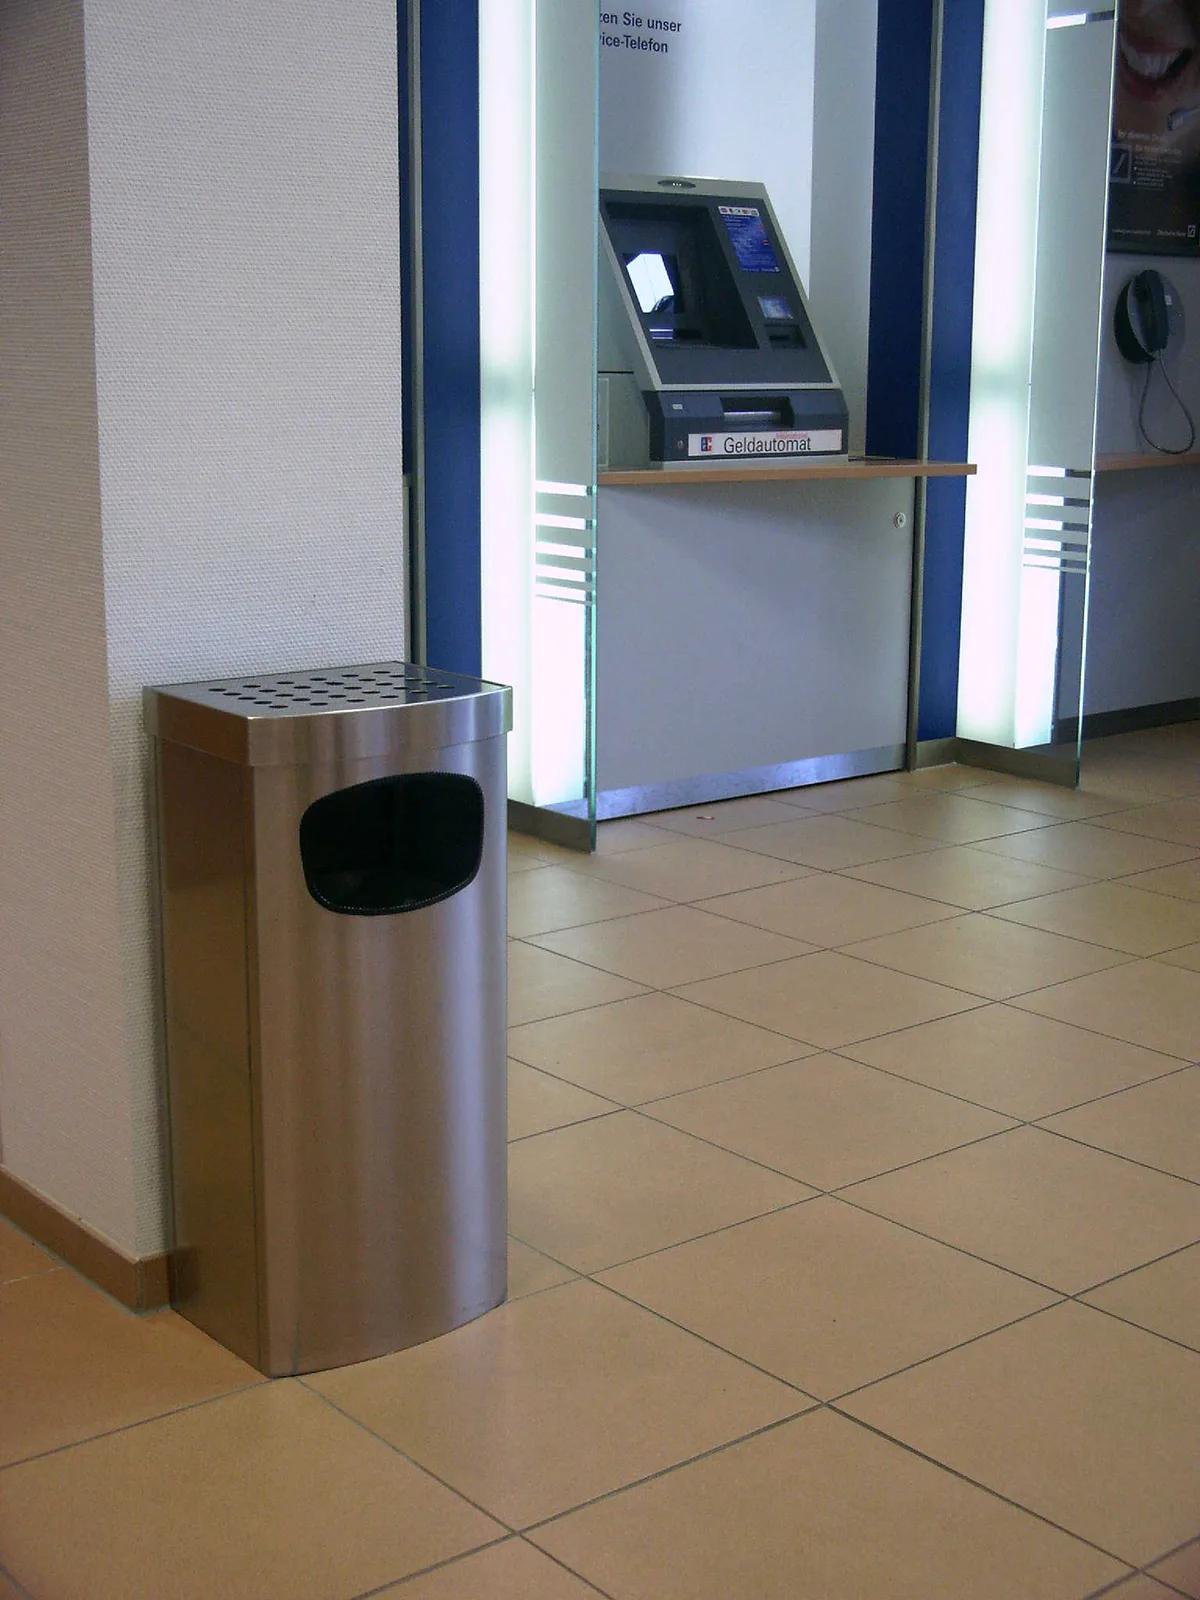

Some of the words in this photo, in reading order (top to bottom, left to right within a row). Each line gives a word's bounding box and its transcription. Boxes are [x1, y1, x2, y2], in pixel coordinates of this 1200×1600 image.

[623, 12, 643, 27] Sie
[647, 18, 682, 32] unser
[600, 32, 668, 53] ice-Telefon
[723, 436, 811, 454] Geldautomat
